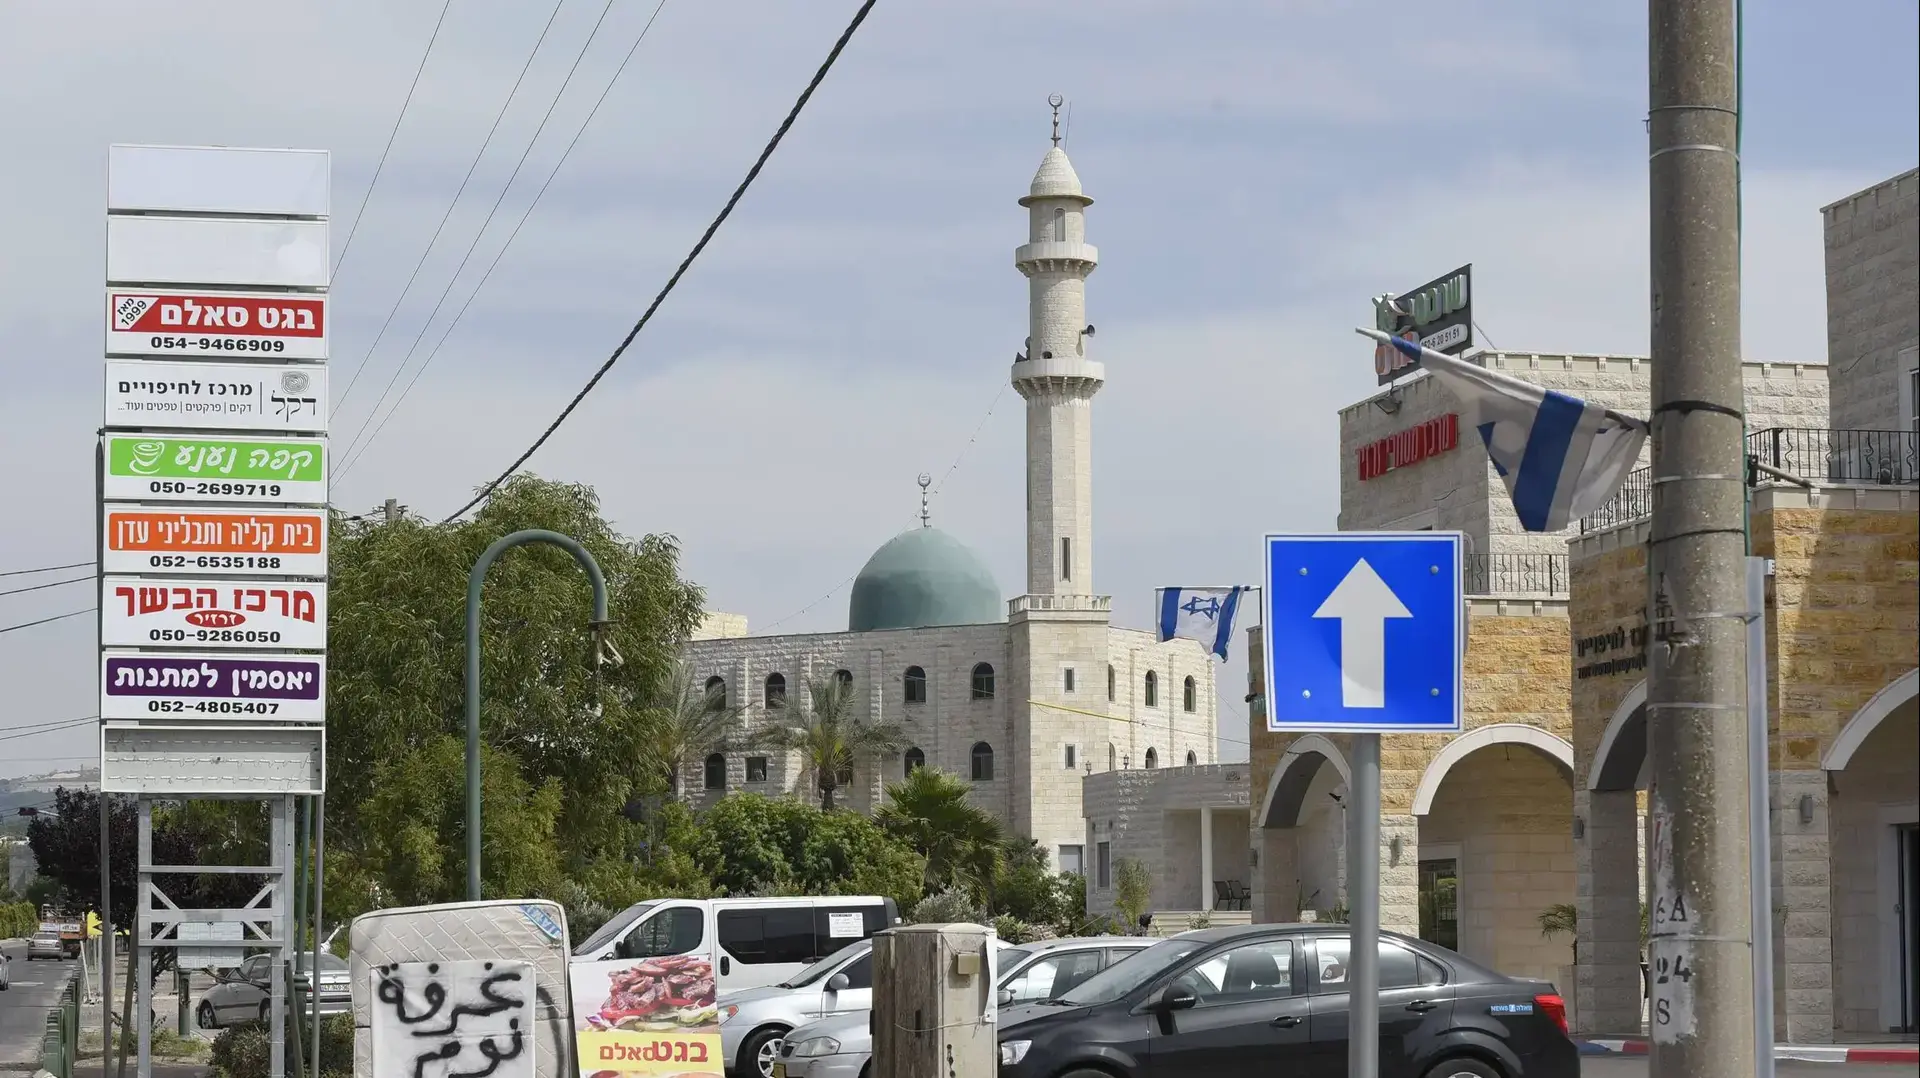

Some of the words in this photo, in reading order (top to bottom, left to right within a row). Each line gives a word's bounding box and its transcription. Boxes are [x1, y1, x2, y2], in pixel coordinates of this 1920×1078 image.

[116, 296, 136, 316] מאז
[121, 299, 147, 326] 1999
[160, 298, 249, 328] סאלם
[258, 306, 315, 330] בגט
[150, 336, 285, 352] 054-9466909
[1445, 331, 1452, 342] 51
[1453, 328, 1460, 339] 51
[118, 380, 201, 396] לחיפויים
[208, 381, 253, 396] מרכז
[146, 401, 178, 412] טפטים
[185, 401, 222, 414] פרקטים
[229, 402, 252, 413] דקים
[271, 391, 317, 422] דקל
[174, 444, 238, 473] נענע
[248, 447, 313, 479] קפה
[149, 481, 281, 497] 050-2699719
[117, 520, 148, 550] עדן
[157, 516, 223, 545] ותבליני
[230, 517, 275, 551] קליה
[282, 523, 314, 548] בית
[149, 555, 281, 570] 052-6535188
[115, 586, 218, 617] הבשר
[233, 589, 316, 624] מרכז
[194, 613, 237, 627] זרזיר
[149, 628, 281, 644] 050-9286050
[113, 661, 219, 688] למתנות
[231, 669, 313, 696] יאסמין
[147, 699, 280, 715] 052-4805407
[377, 961, 525, 1037] غرفة
[599, 1042, 654, 1062] סאלם
[652, 1040, 709, 1063] בגט
